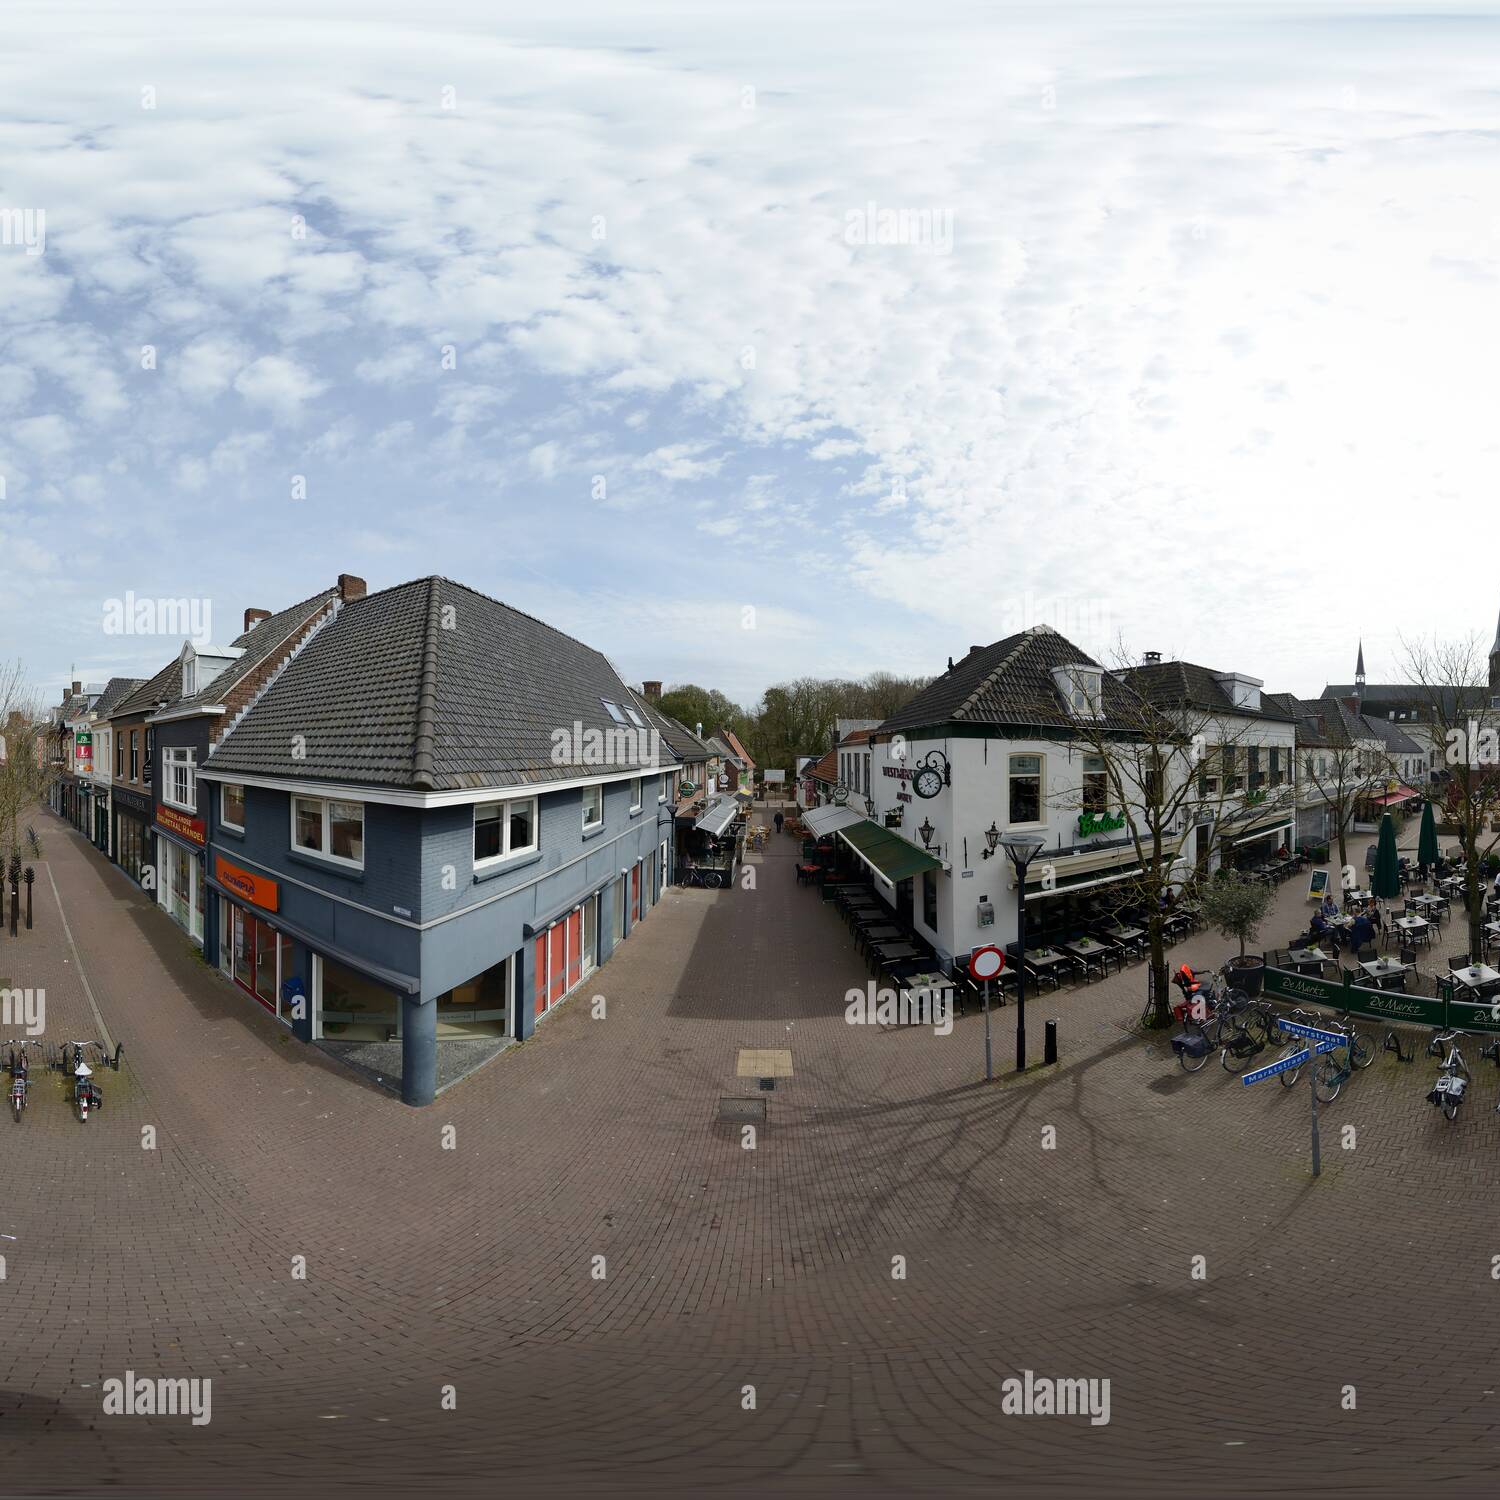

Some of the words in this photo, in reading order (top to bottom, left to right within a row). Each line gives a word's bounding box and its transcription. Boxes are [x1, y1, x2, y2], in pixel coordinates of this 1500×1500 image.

[183, 824, 205, 842] HANDEL
[1282, 976, 1294, 988] De
[1295, 980, 1325, 996] Markt
[1370, 996, 1384, 1007] De
[1385, 999, 1421, 1013] Markt
[1474, 1010, 1489, 1021] De
[1284, 1024, 1340, 1044] Weverstraat
[1248, 1054, 1306, 1082] Marktstraat
